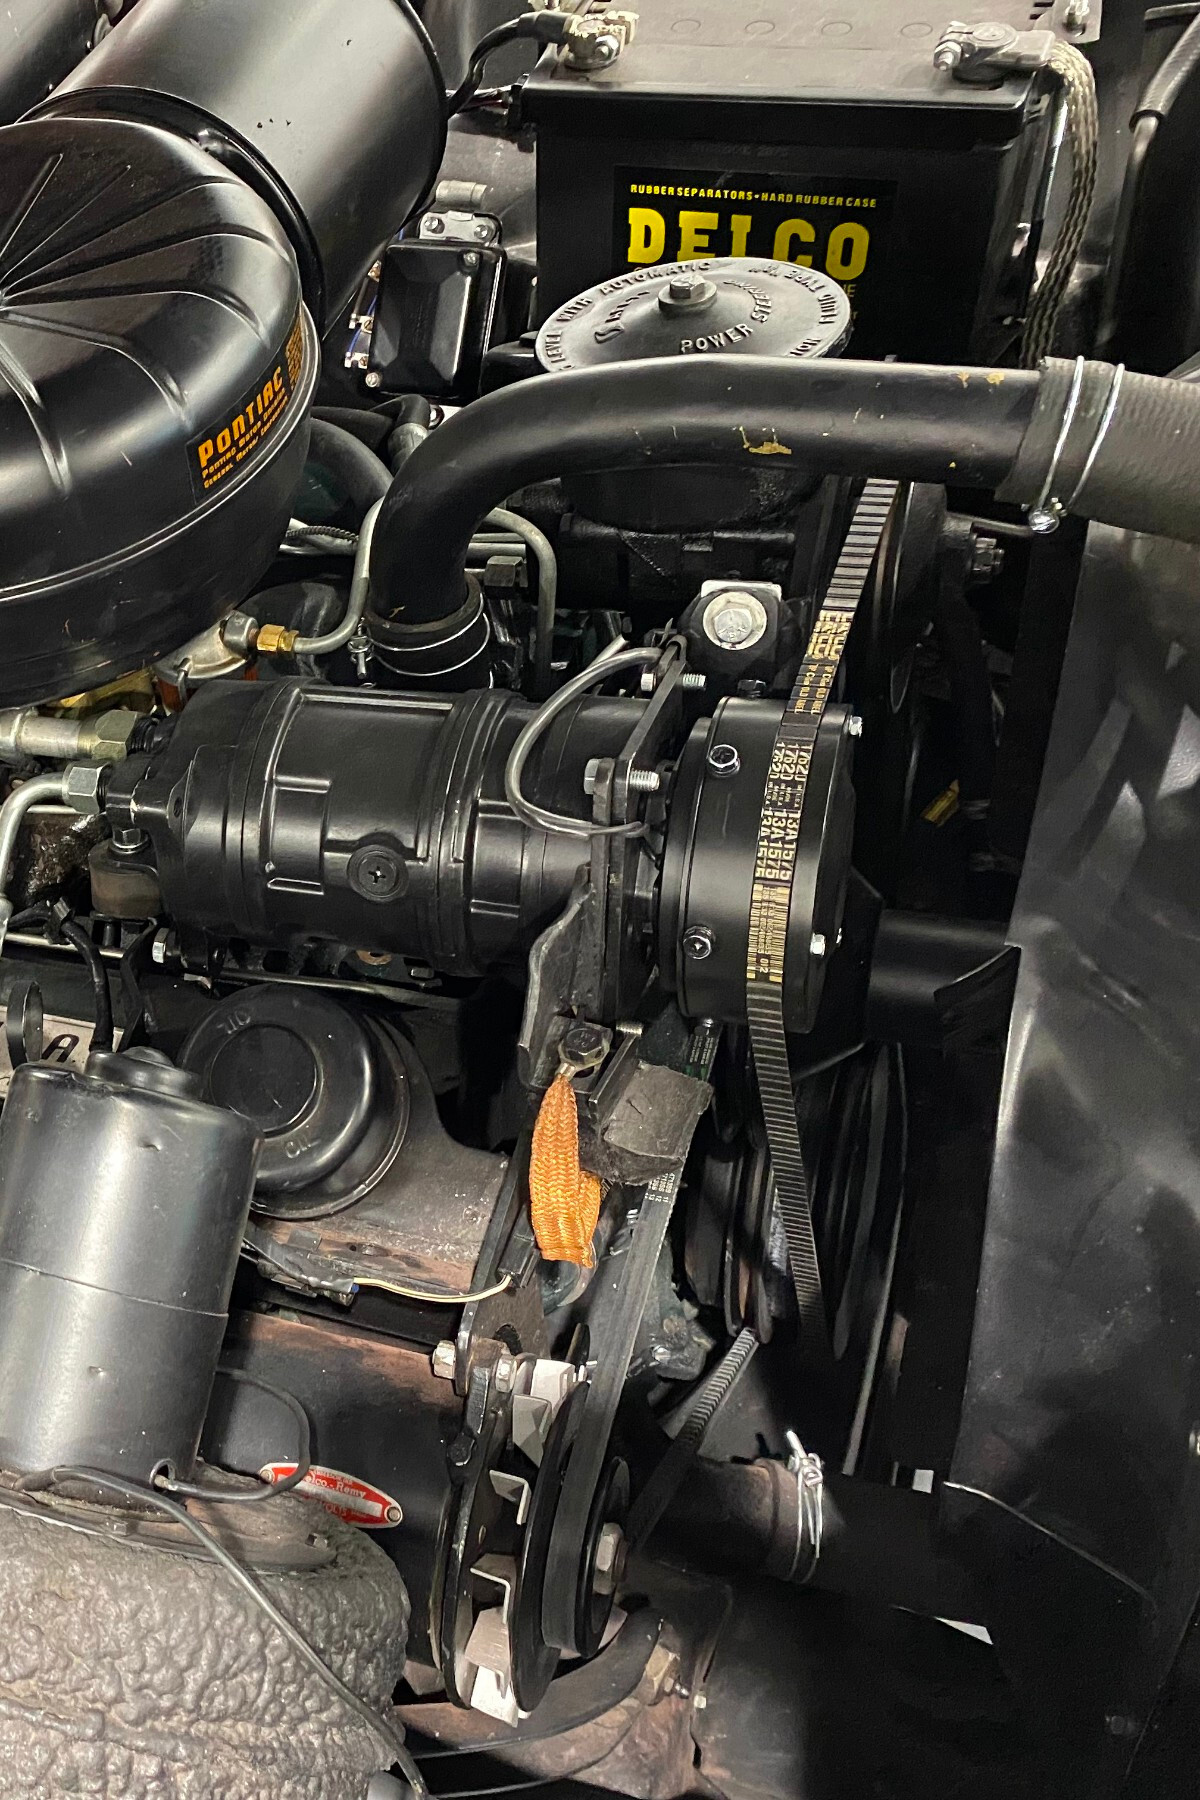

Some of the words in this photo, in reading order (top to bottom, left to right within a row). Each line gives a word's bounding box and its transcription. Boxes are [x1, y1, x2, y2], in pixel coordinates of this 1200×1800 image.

[630, 184, 675, 197] RUBBER
[676, 187, 753, 201] SEPARATORS
[760, 192, 794, 204] HARD
[795, 194, 844, 207] RUBBER
[845, 197, 877, 209] CASE
[627, 207, 871, 281] DELCO
[557, 297, 593, 322] WITH
[599, 261, 712, 296] AUTOMATIC
[680, 323, 754, 354] POWER
[197, 366, 283, 469] PONTIAC
[780, 742, 800, 781] 17620
[765, 808, 787, 879] 13A1575
